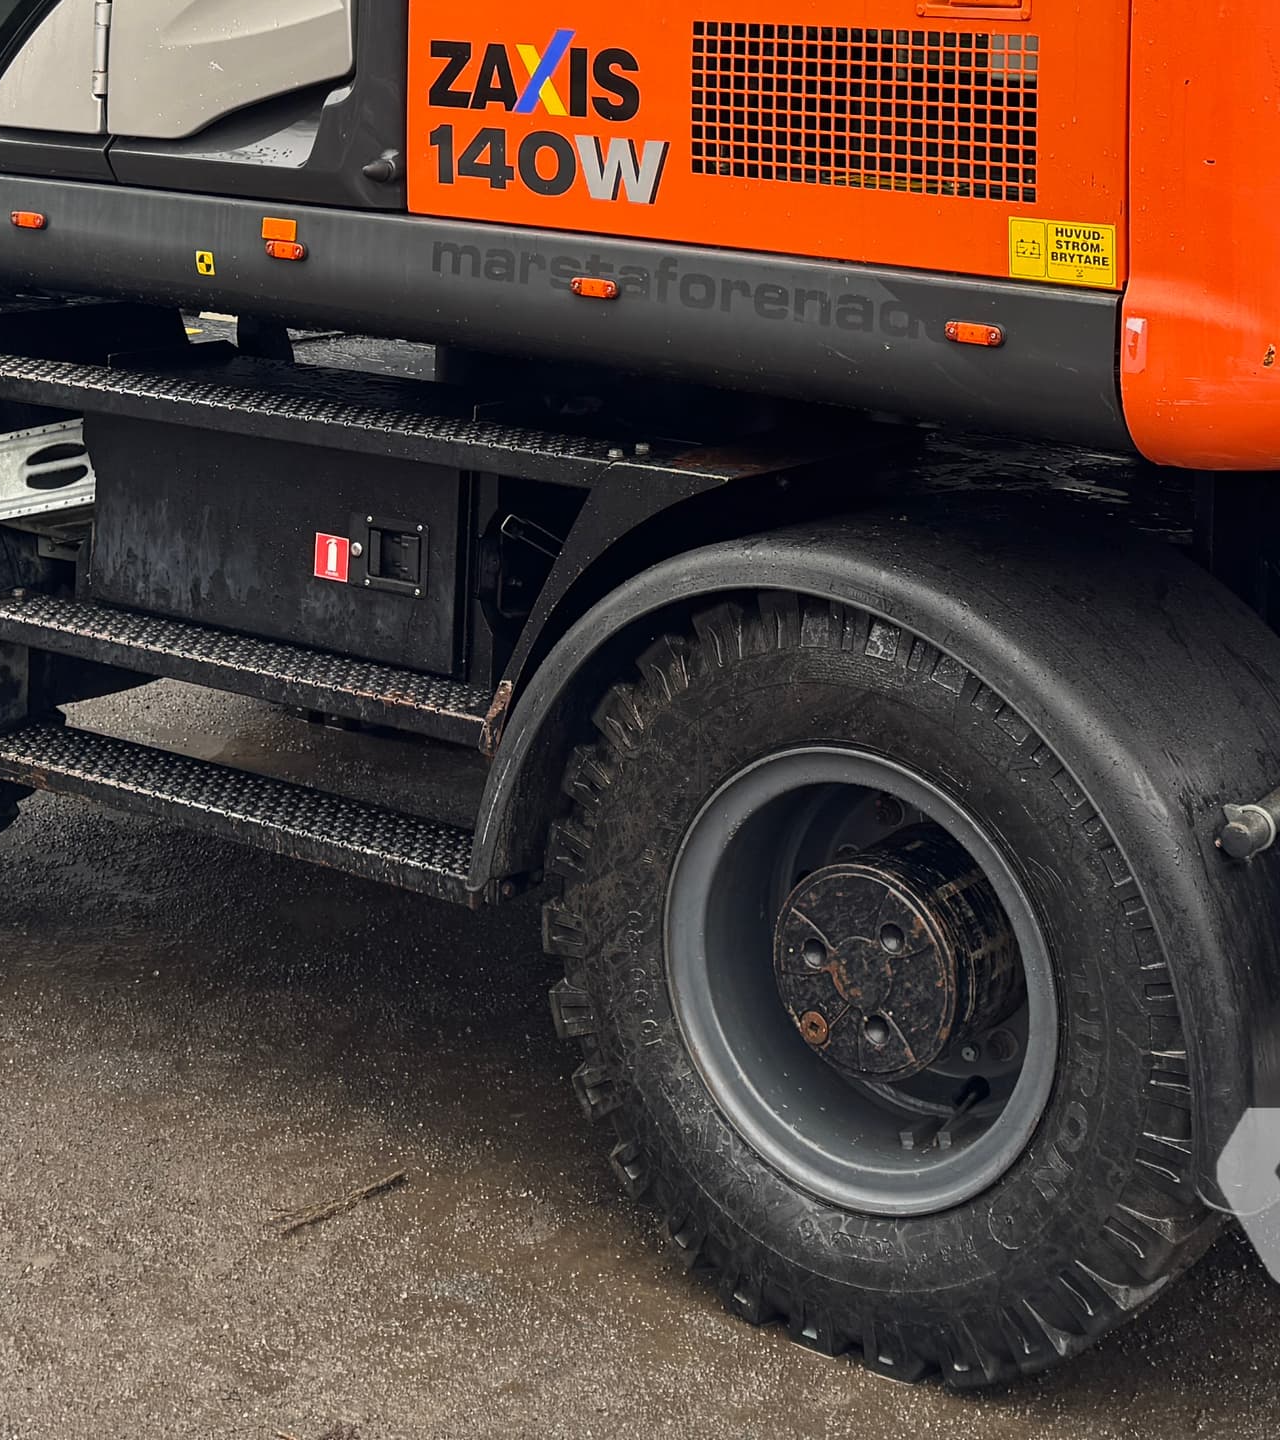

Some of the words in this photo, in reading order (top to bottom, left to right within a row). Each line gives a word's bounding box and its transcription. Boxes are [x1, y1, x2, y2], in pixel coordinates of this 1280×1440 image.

[428, 29, 640, 122] ZAXIS
[429, 124, 670, 205] 140W
[1055, 227, 1104, 241] HUVUD-
[1051, 252, 1109, 267] BRYTARE
